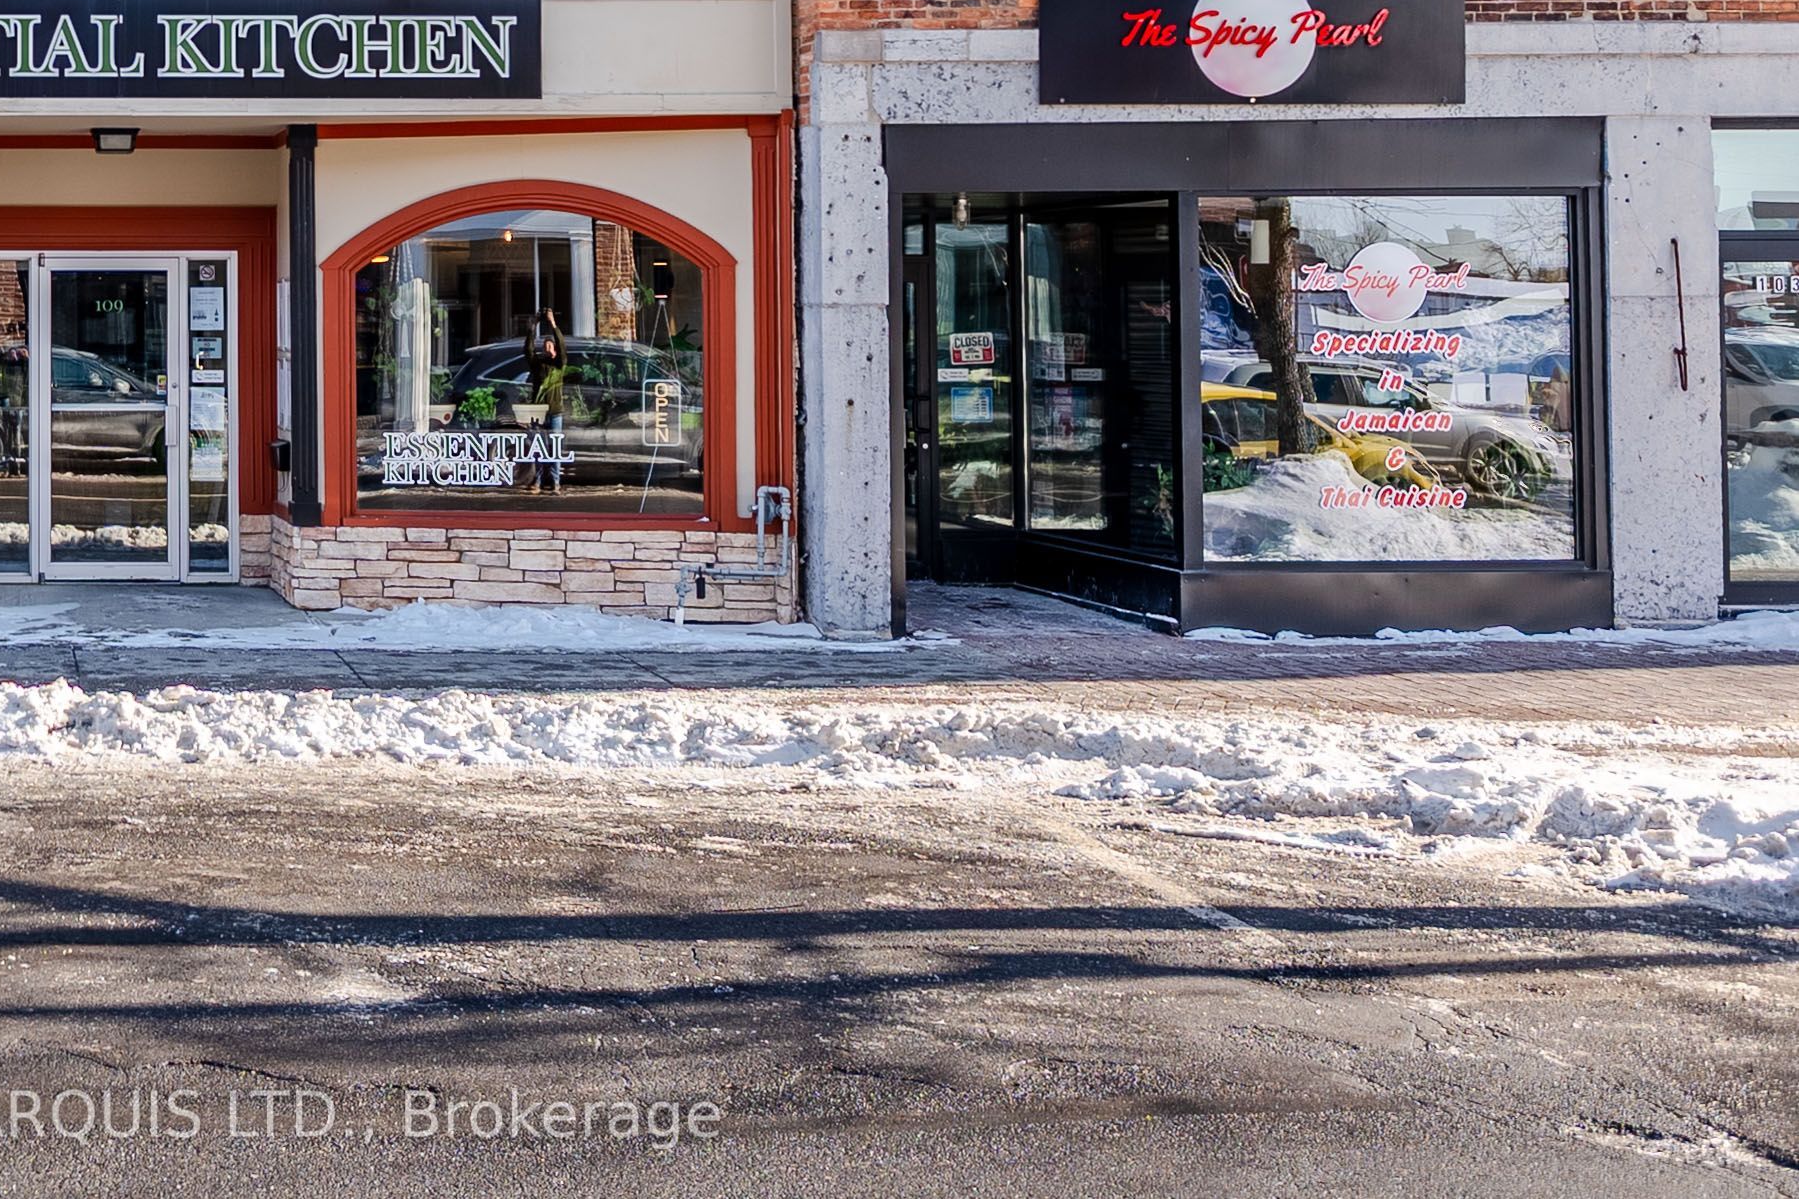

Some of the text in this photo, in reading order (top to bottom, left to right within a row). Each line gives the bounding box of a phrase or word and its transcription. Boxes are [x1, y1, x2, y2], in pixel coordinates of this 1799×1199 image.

[1121, 8, 1390, 58] The Spicy Pearl
[157, 13, 518, 79] KITCHEN
[1301, 263, 1471, 297] The Spicy Pearl
[95, 299, 125, 313] 109
[954, 335, 990, 348] CLOSED
[1312, 330, 1462, 358] Specializing
[1379, 370, 1404, 392] in
[654, 382, 670, 444] OPEN
[1338, 407, 1452, 432] Jamaican
[382, 432, 575, 462] ESSENTIAL
[1385, 447, 1406, 471] &
[382, 461, 515, 486] KITCHEN
[1321, 486, 1467, 509] Thai Cuisine
